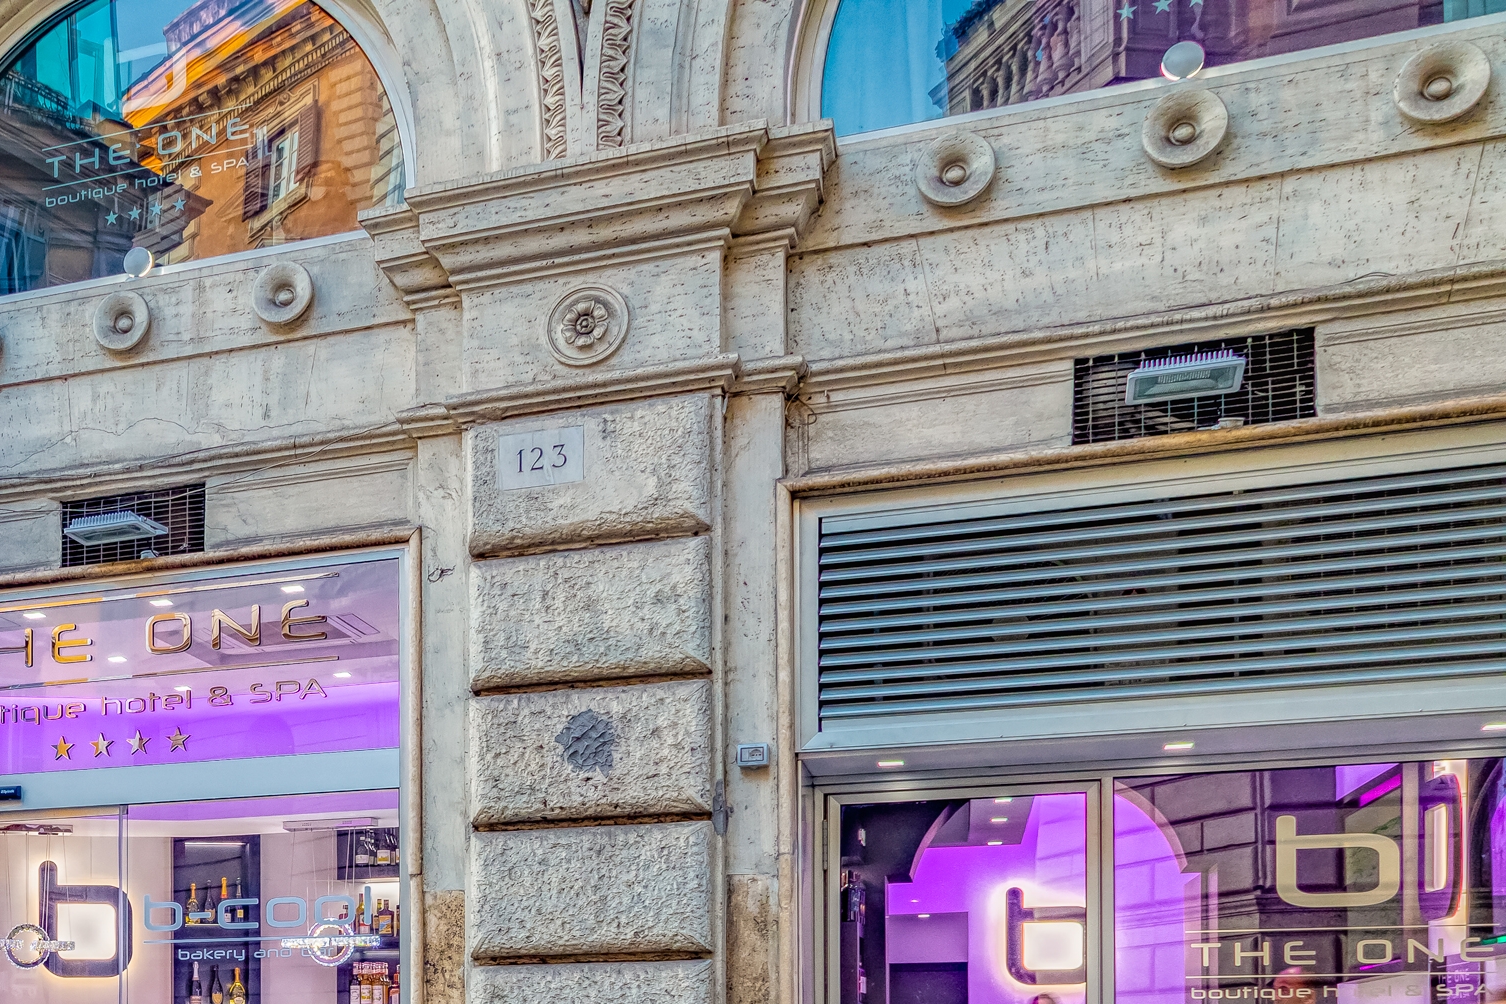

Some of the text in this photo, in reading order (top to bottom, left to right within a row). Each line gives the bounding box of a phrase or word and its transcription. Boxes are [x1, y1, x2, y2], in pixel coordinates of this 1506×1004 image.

[46, 117, 250, 178] THE ONE
[45, 157, 249, 208] boutique hotel & SPA
[517, 443, 567, 473] 123
[146, 599, 328, 655] ONE
[101, 689, 191, 715] hotel
[207, 686, 233, 706] &
[250, 678, 327, 704] SPA
[144, 886, 372, 932] b-cool
[178, 948, 245, 961] bakery
[254, 947, 292, 958] and
[1191, 937, 1494, 967] THE ONE
[1191, 986, 1312, 1000] boutique
